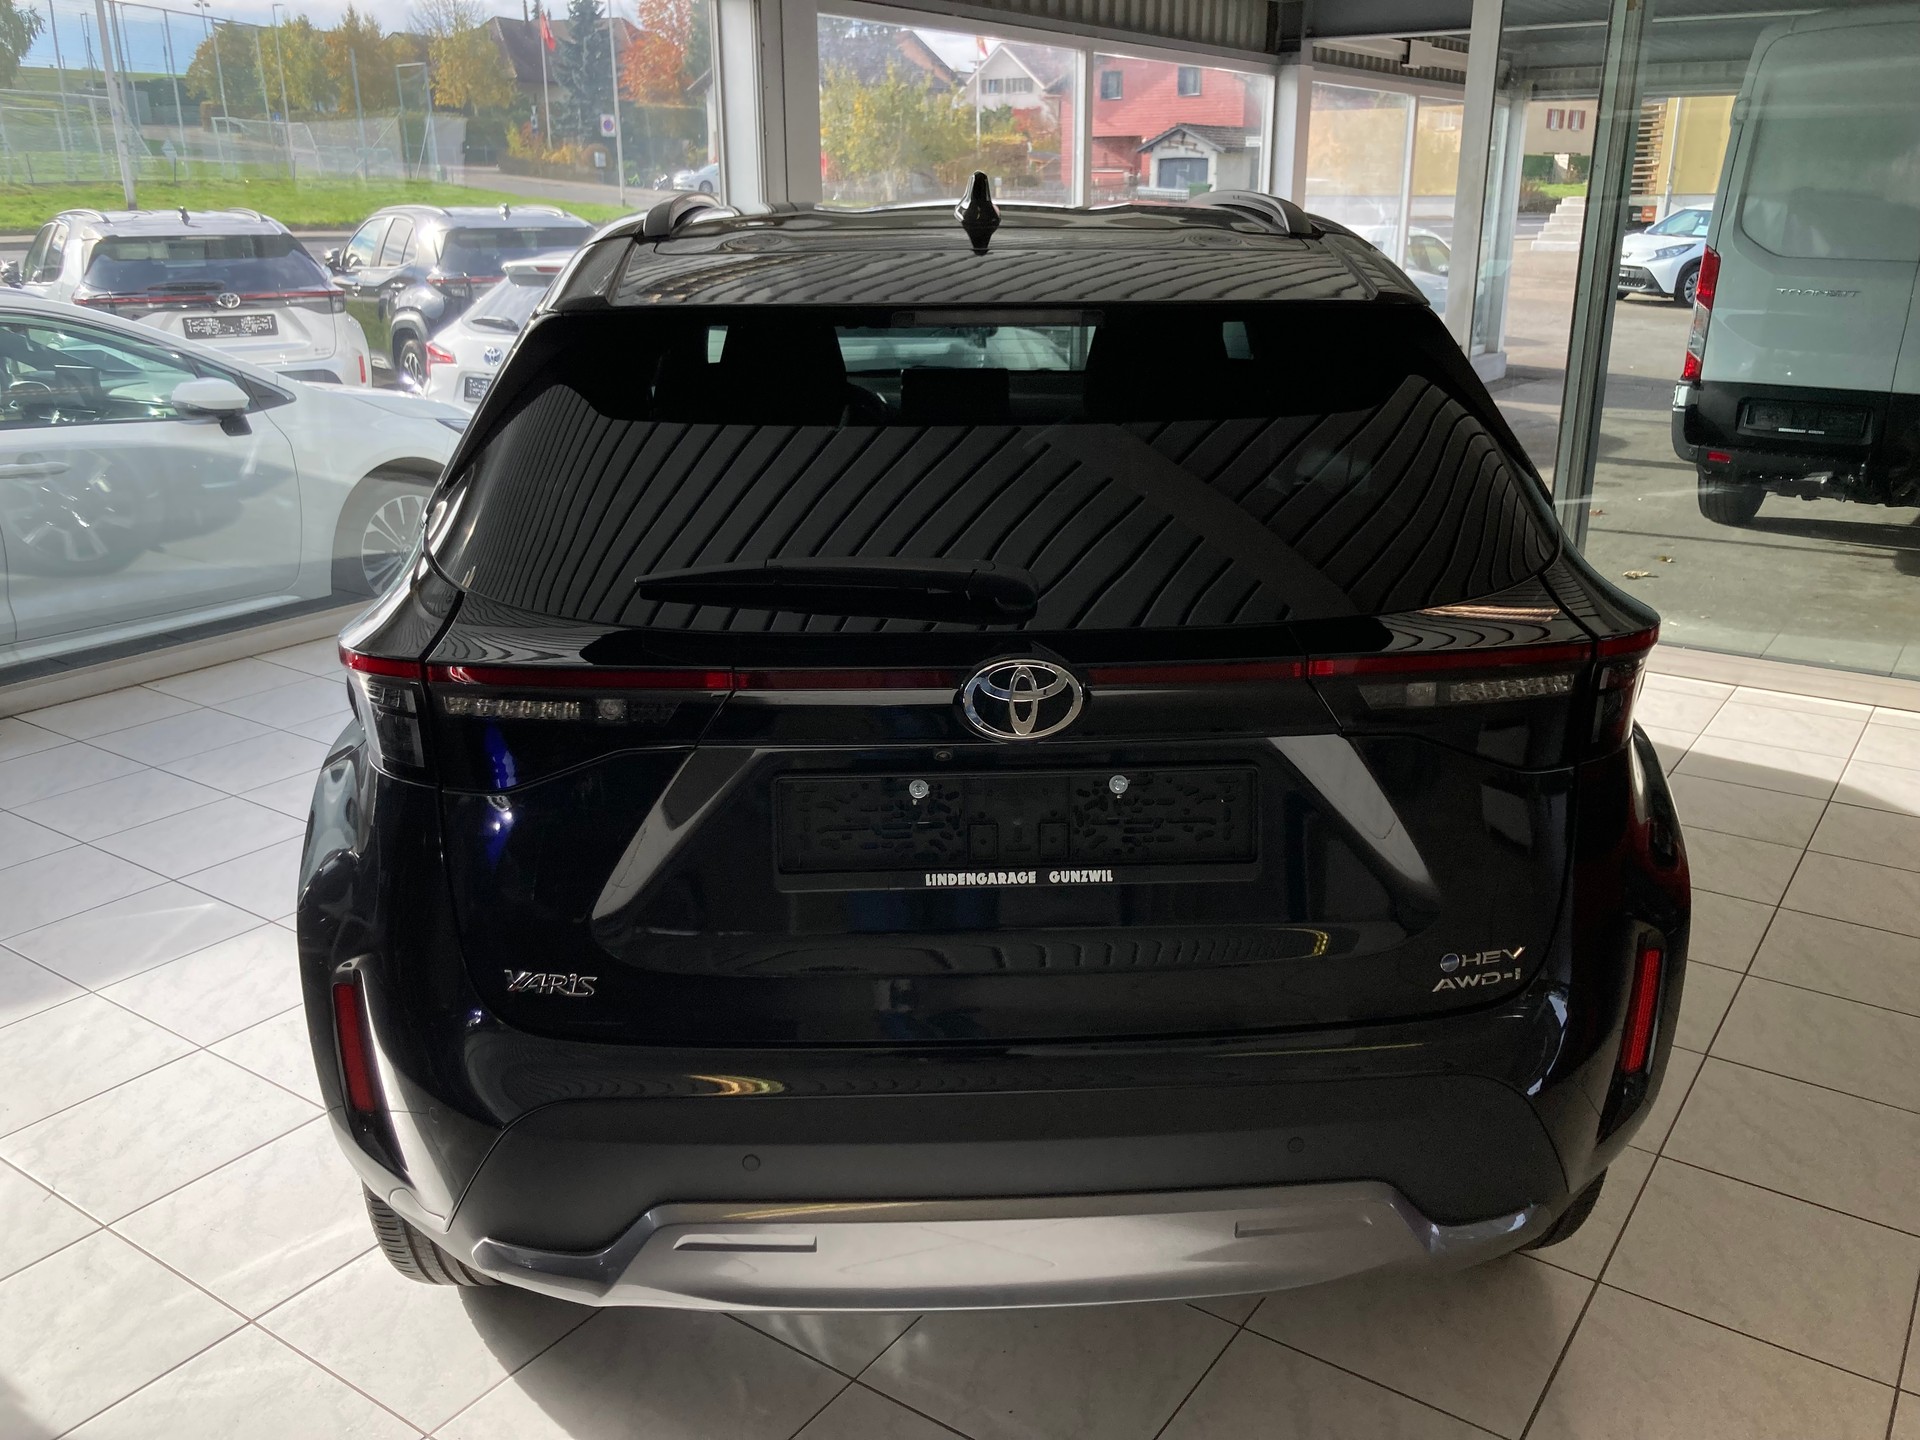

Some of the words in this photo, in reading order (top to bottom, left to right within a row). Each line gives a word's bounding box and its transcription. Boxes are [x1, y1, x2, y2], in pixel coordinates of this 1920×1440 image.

[925, 871, 1036, 886] LINDENGARAGE
[1049, 870, 1113, 882] GUNZWIL
[1462, 947, 1525, 966] HEV
